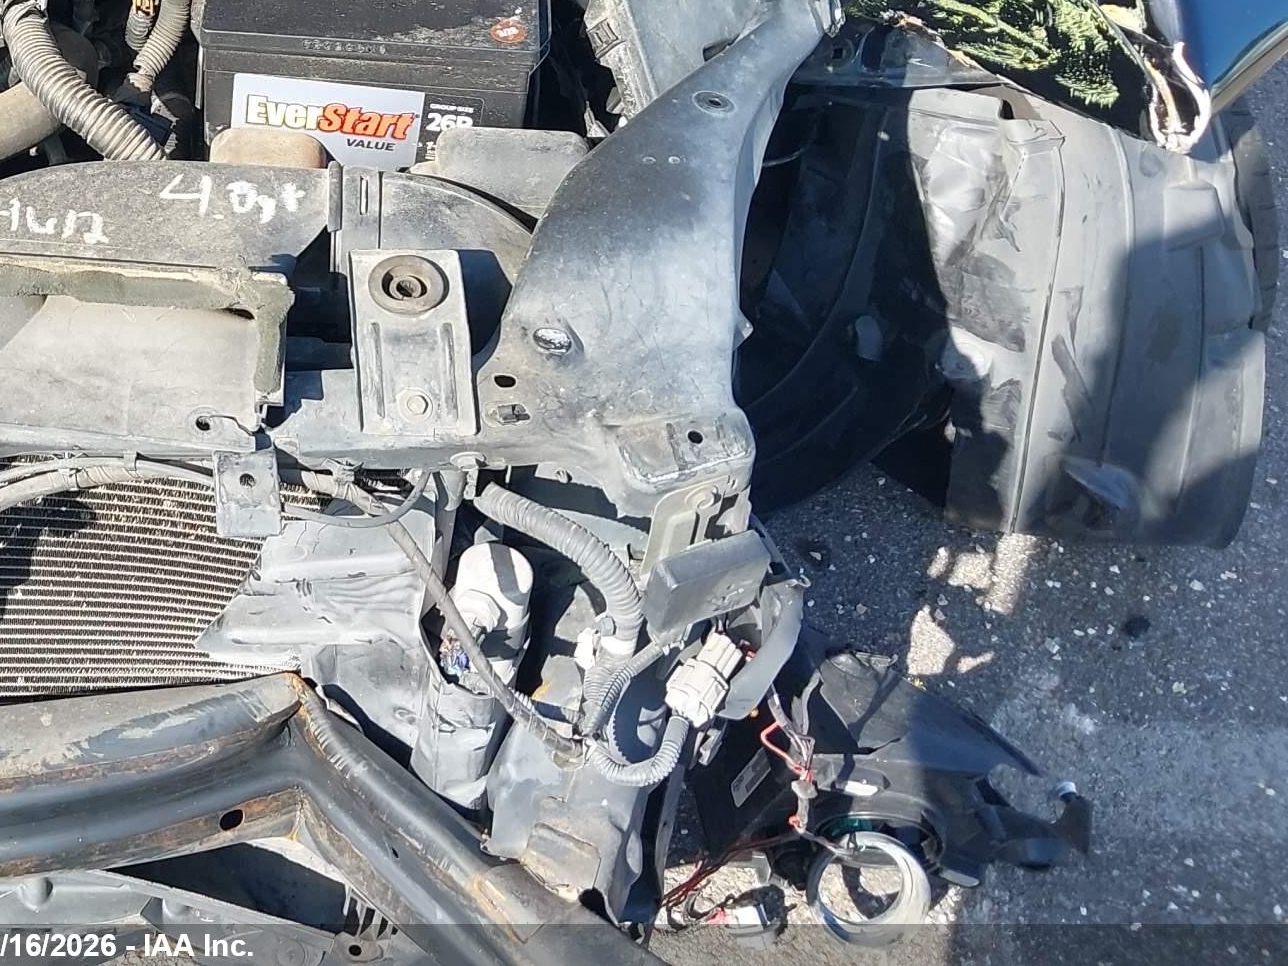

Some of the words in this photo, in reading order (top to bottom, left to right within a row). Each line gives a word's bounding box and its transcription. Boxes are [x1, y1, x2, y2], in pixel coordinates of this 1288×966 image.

[429, 103, 456, 111] GROUP
[246, 94, 416, 140] EverStart
[346, 138, 397, 152] VALUE
